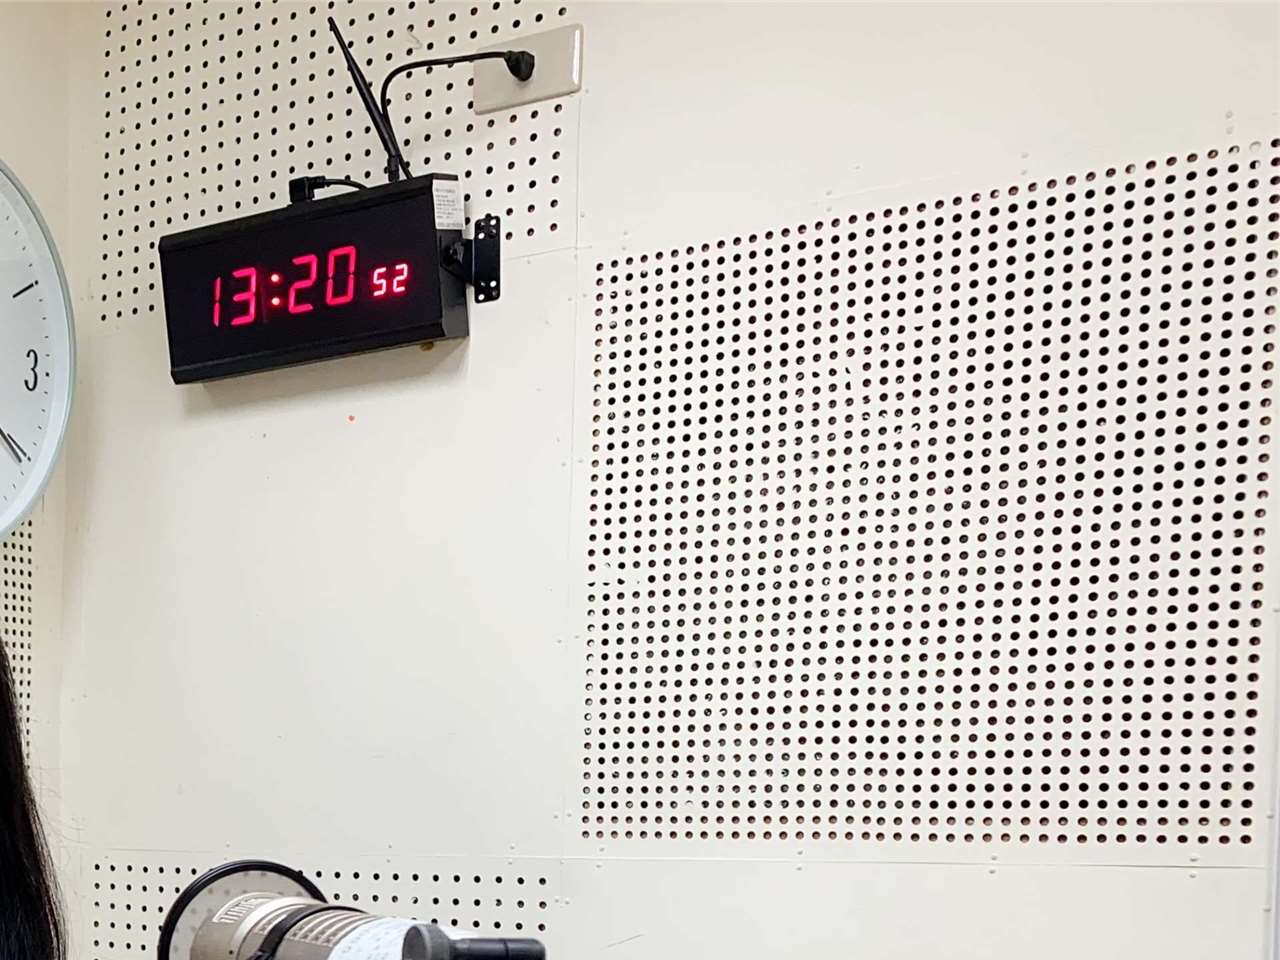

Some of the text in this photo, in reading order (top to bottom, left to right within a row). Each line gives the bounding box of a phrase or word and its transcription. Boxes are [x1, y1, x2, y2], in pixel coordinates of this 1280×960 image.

[213, 245, 408, 328] 13:20 52
[24, 349, 39, 392] 3
